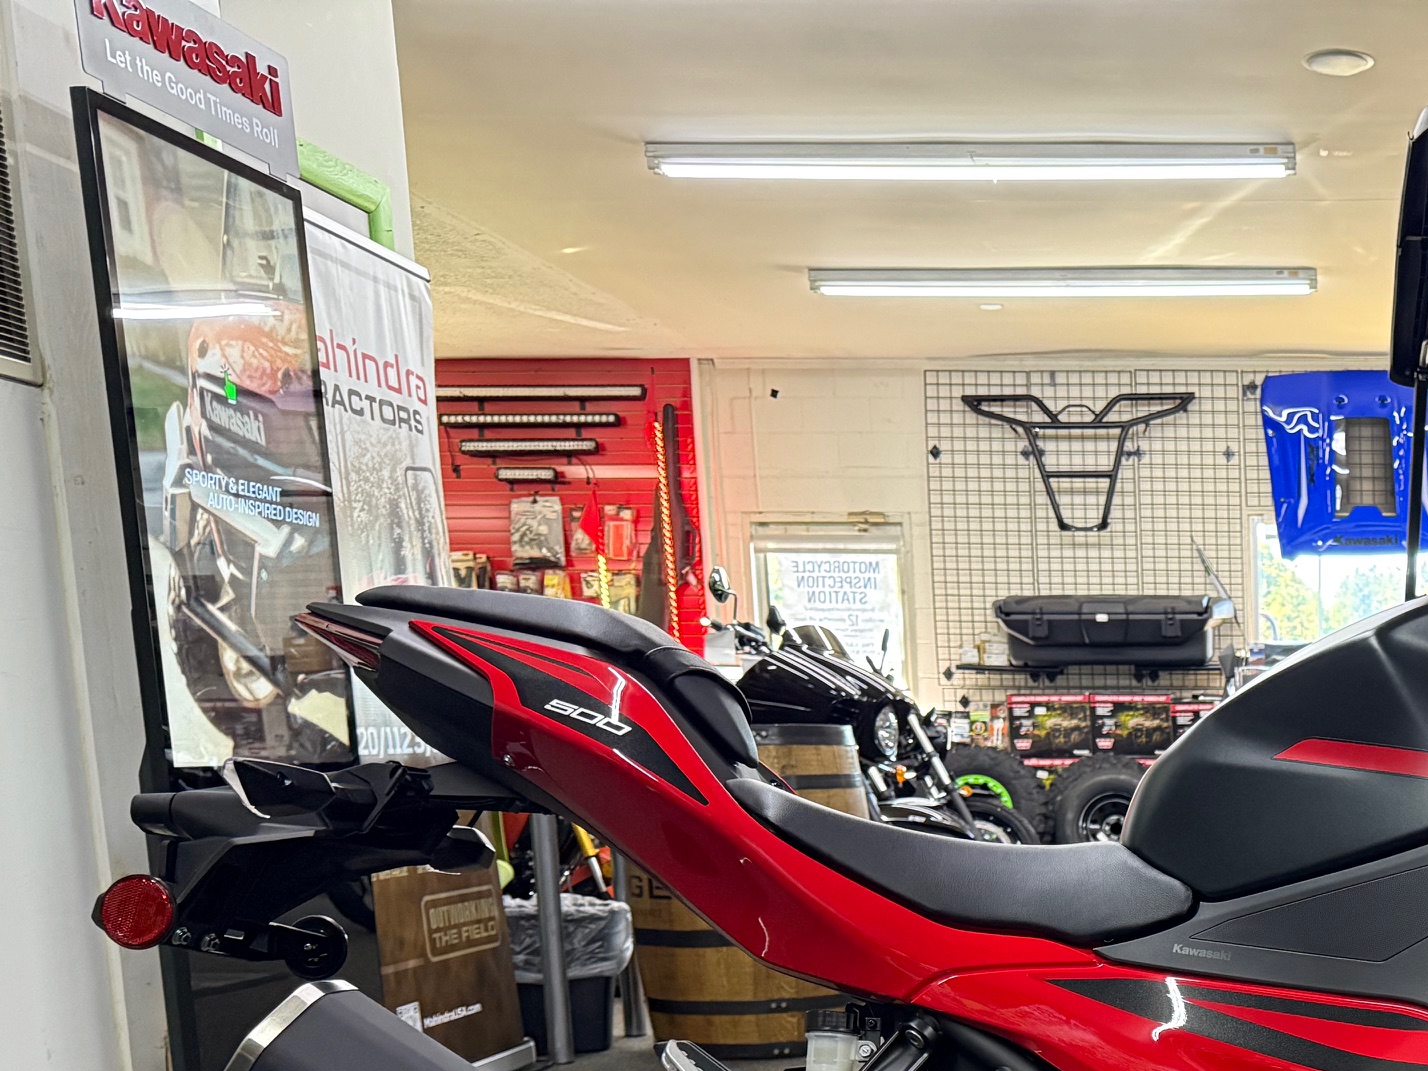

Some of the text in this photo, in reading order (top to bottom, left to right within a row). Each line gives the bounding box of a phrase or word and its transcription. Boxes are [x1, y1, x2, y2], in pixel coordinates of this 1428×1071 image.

[104, 38, 279, 148] Let the Good Times Roll
[203, 389, 267, 447] Kawasaki
[185, 468, 282, 502] SPORTY & ELEGANT
[207, 492, 321, 528] AUTO-INSPIRED DESIGN
[543, 698, 633, 736] 500
[432, 921, 497, 948] THE FIELD
[1172, 943, 1232, 961] Kawasaki
